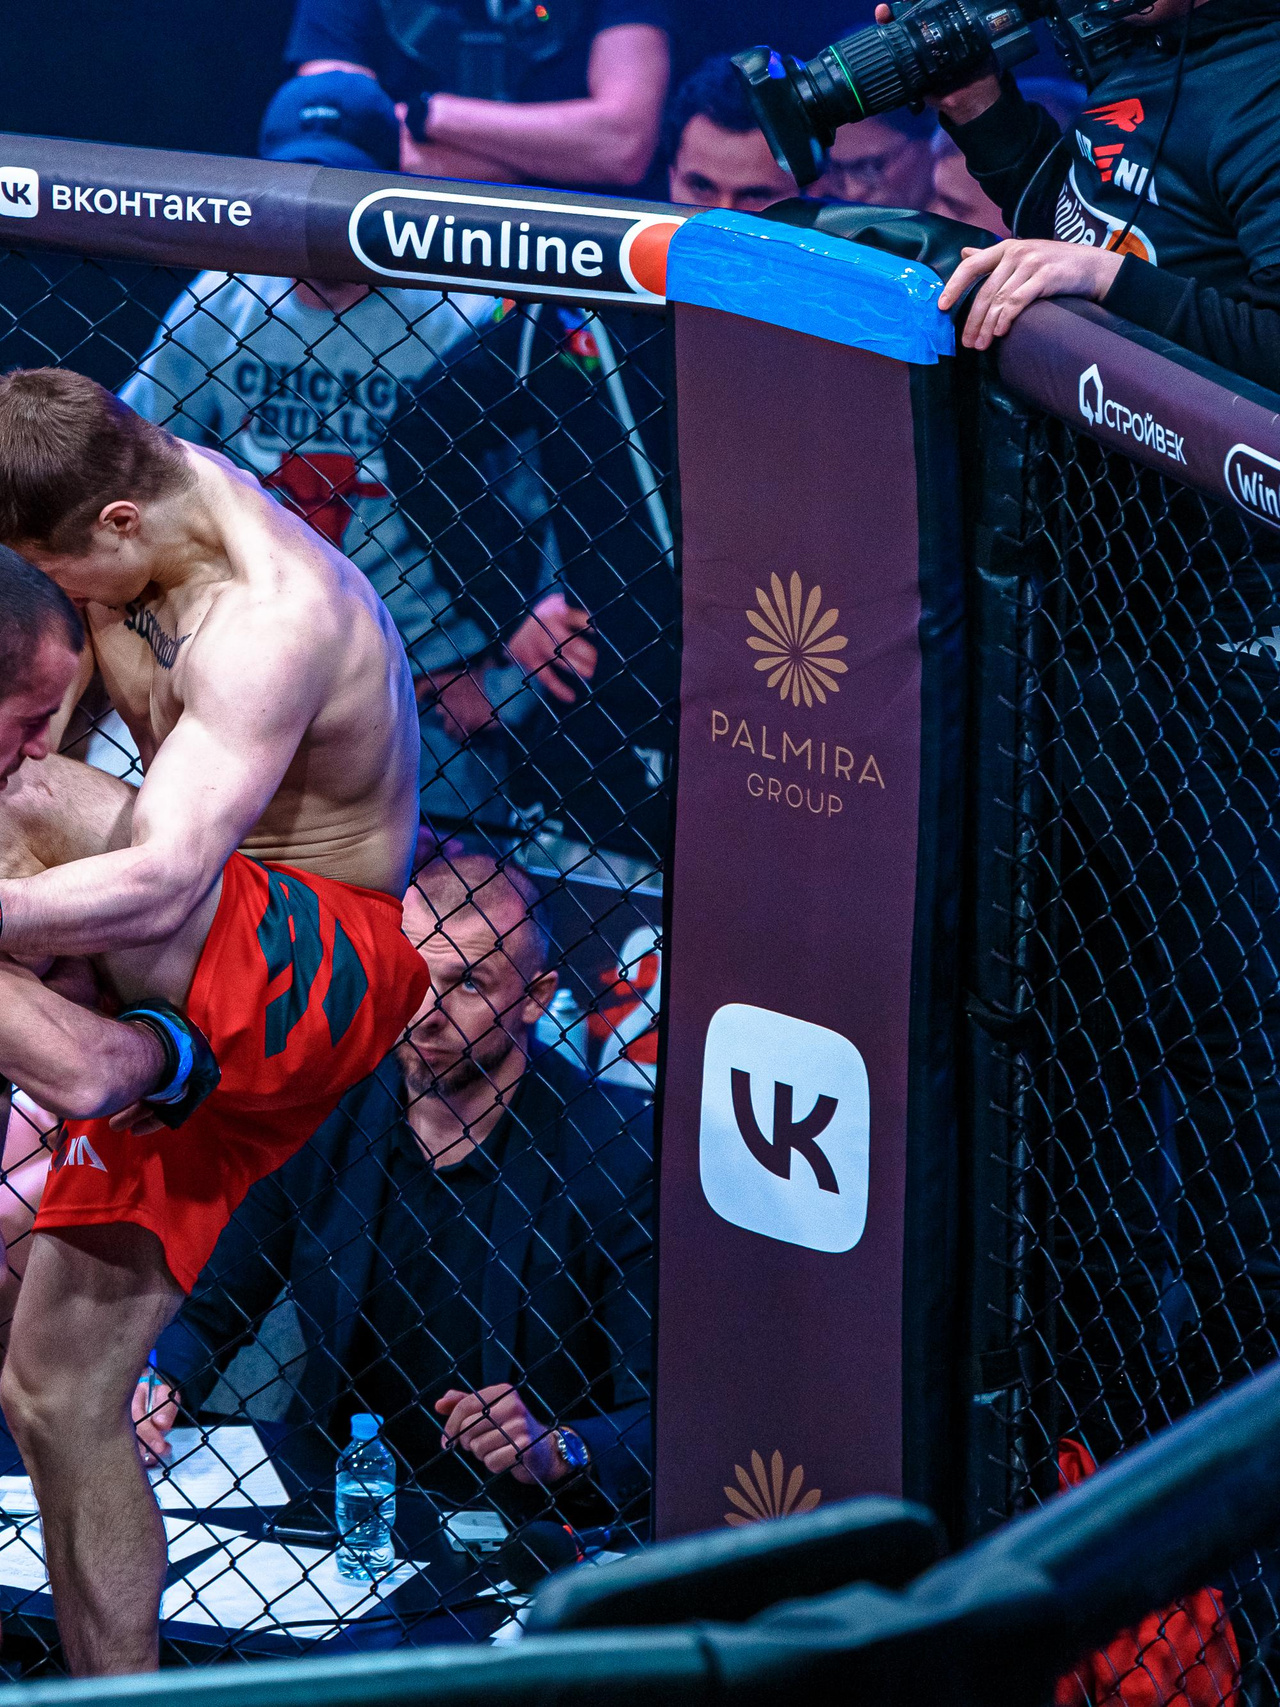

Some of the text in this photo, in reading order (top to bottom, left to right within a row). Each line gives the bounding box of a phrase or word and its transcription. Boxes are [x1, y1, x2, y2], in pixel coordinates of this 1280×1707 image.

[382, 209, 604, 278] Winline
[1054, 182, 1097, 247] inline
[1104, 398, 1189, 466] СТРОЙВЕК
[1235, 462, 1280, 519] Win
[711, 709, 886, 790] PALMIRA
[746, 772, 843, 819] GROUP
